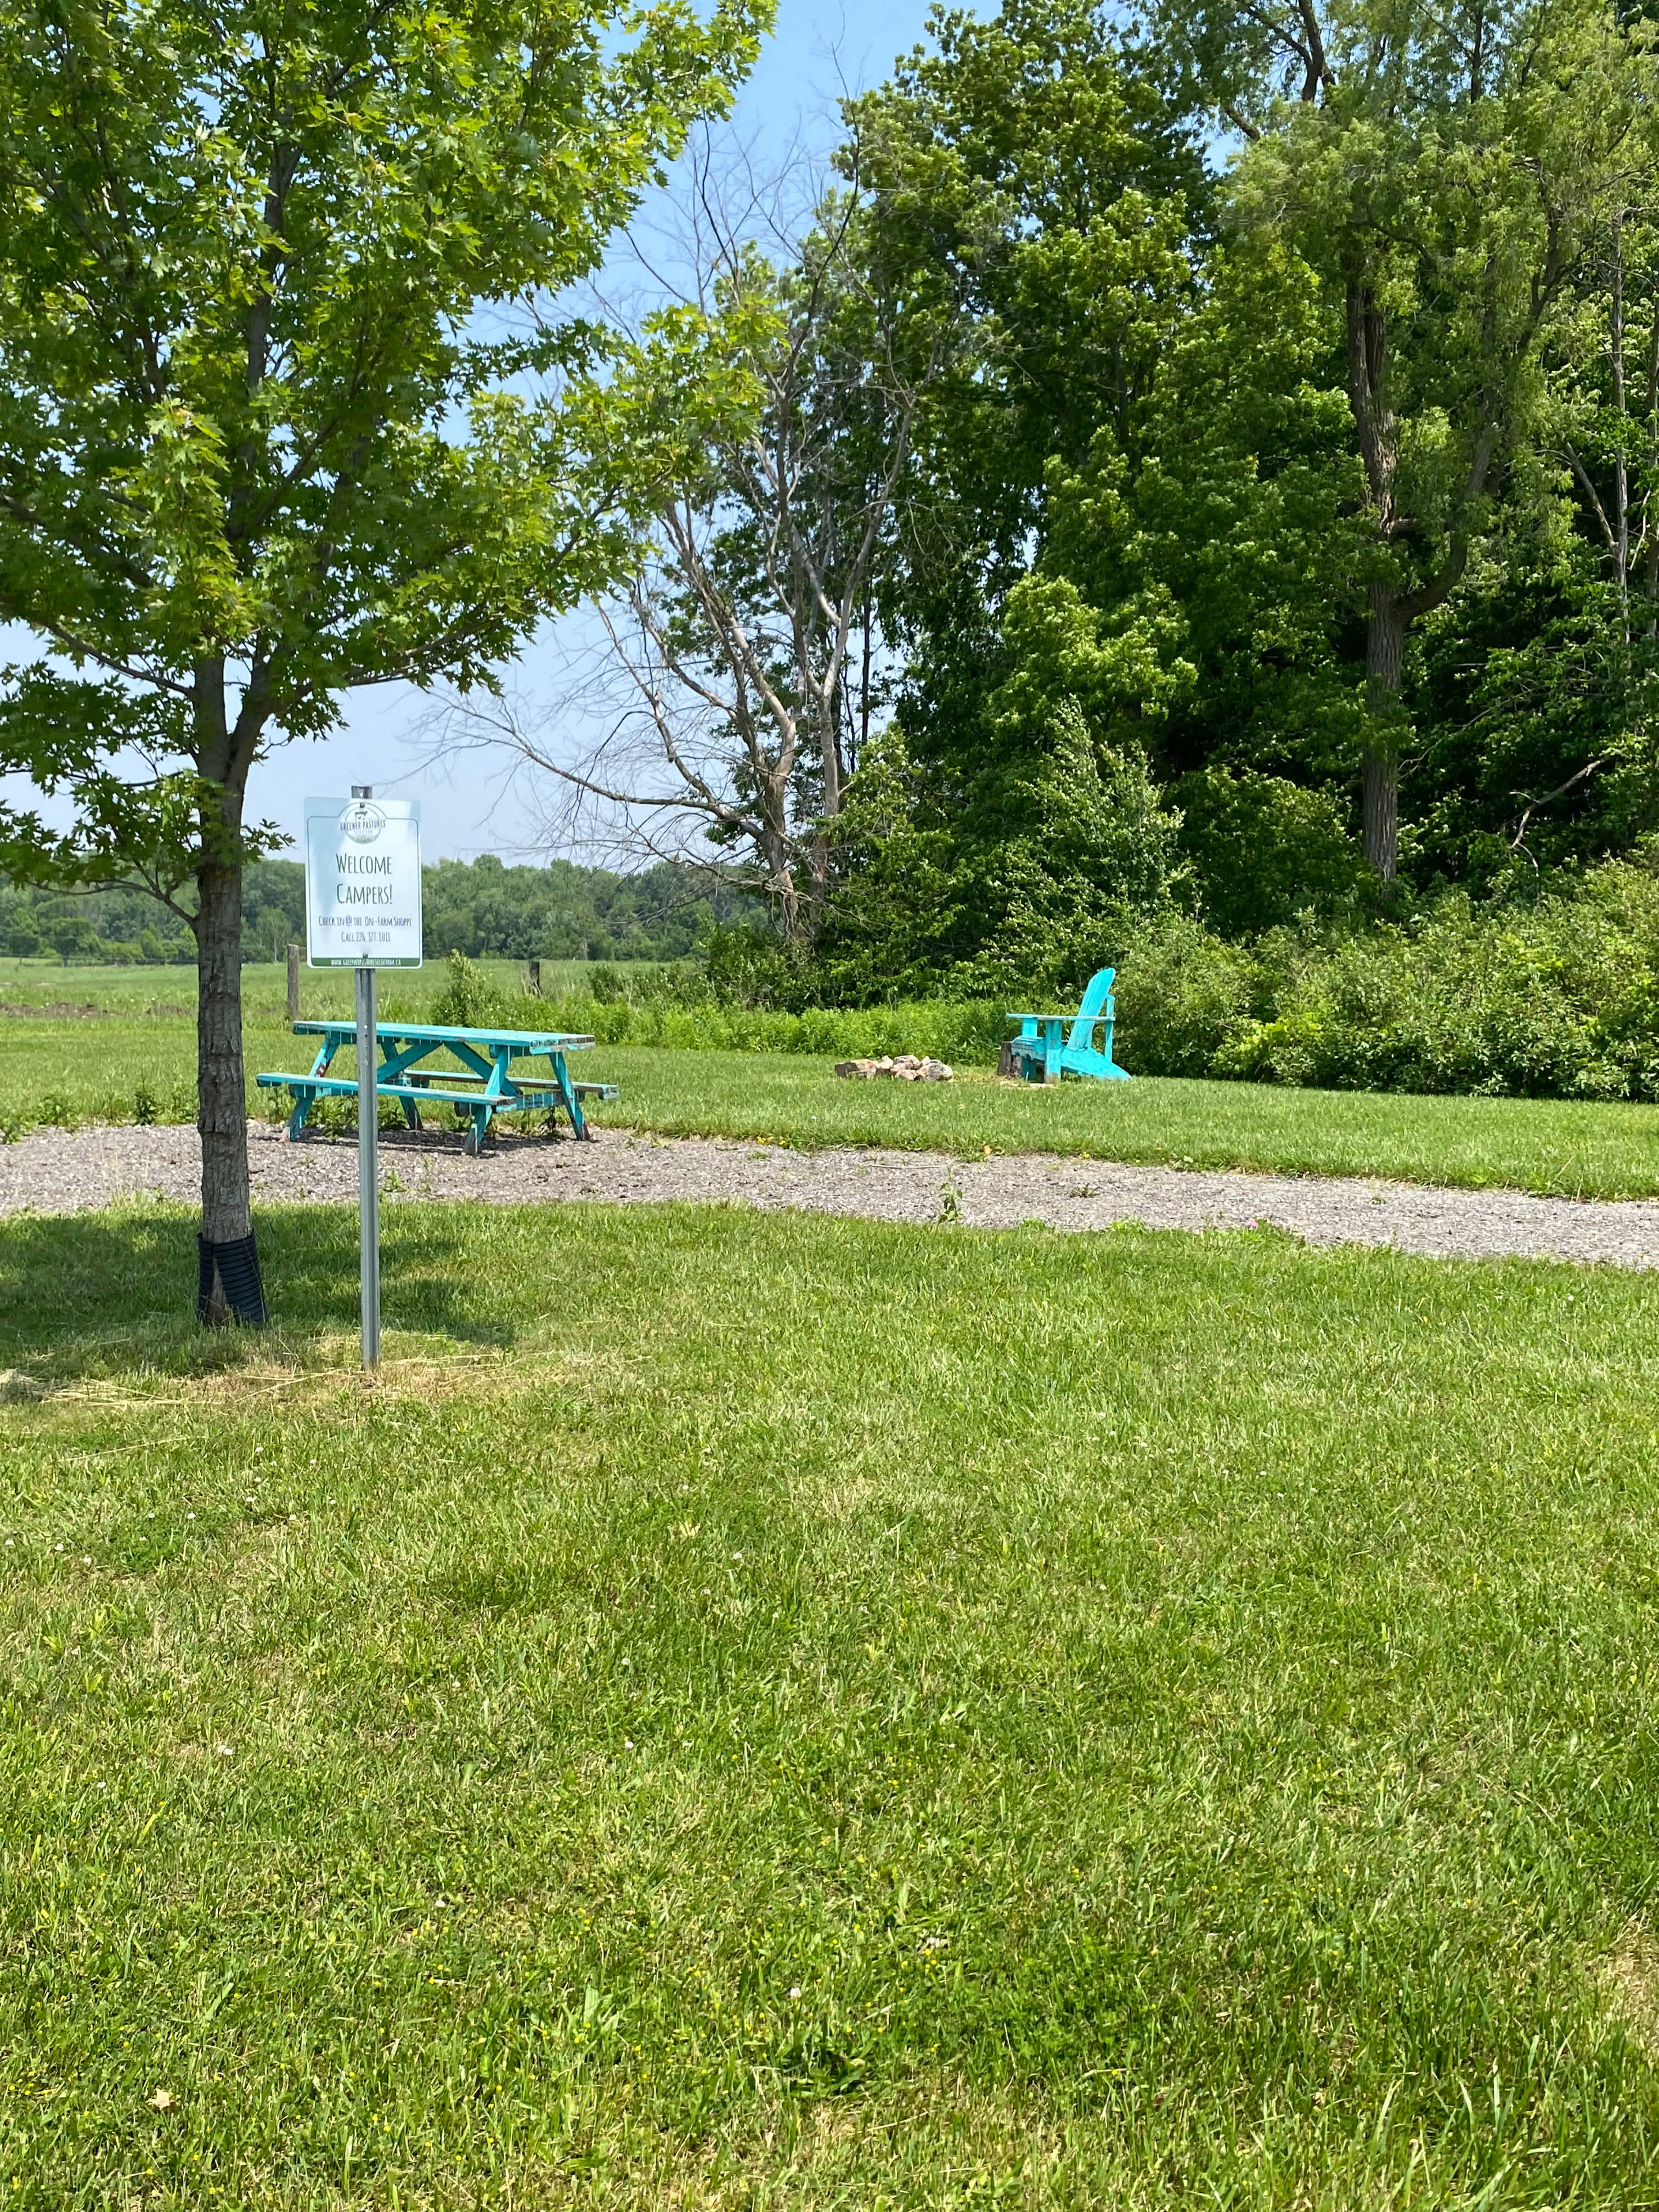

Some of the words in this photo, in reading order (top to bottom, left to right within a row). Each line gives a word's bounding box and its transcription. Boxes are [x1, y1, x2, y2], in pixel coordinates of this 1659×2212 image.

[340, 822, 360, 831] GREENER
[363, 819, 386, 830] PASTURES
[336, 852, 392, 875] WELCOME
[337, 883, 392, 905] CAMPERS!
[341, 932, 354, 942] CALL
